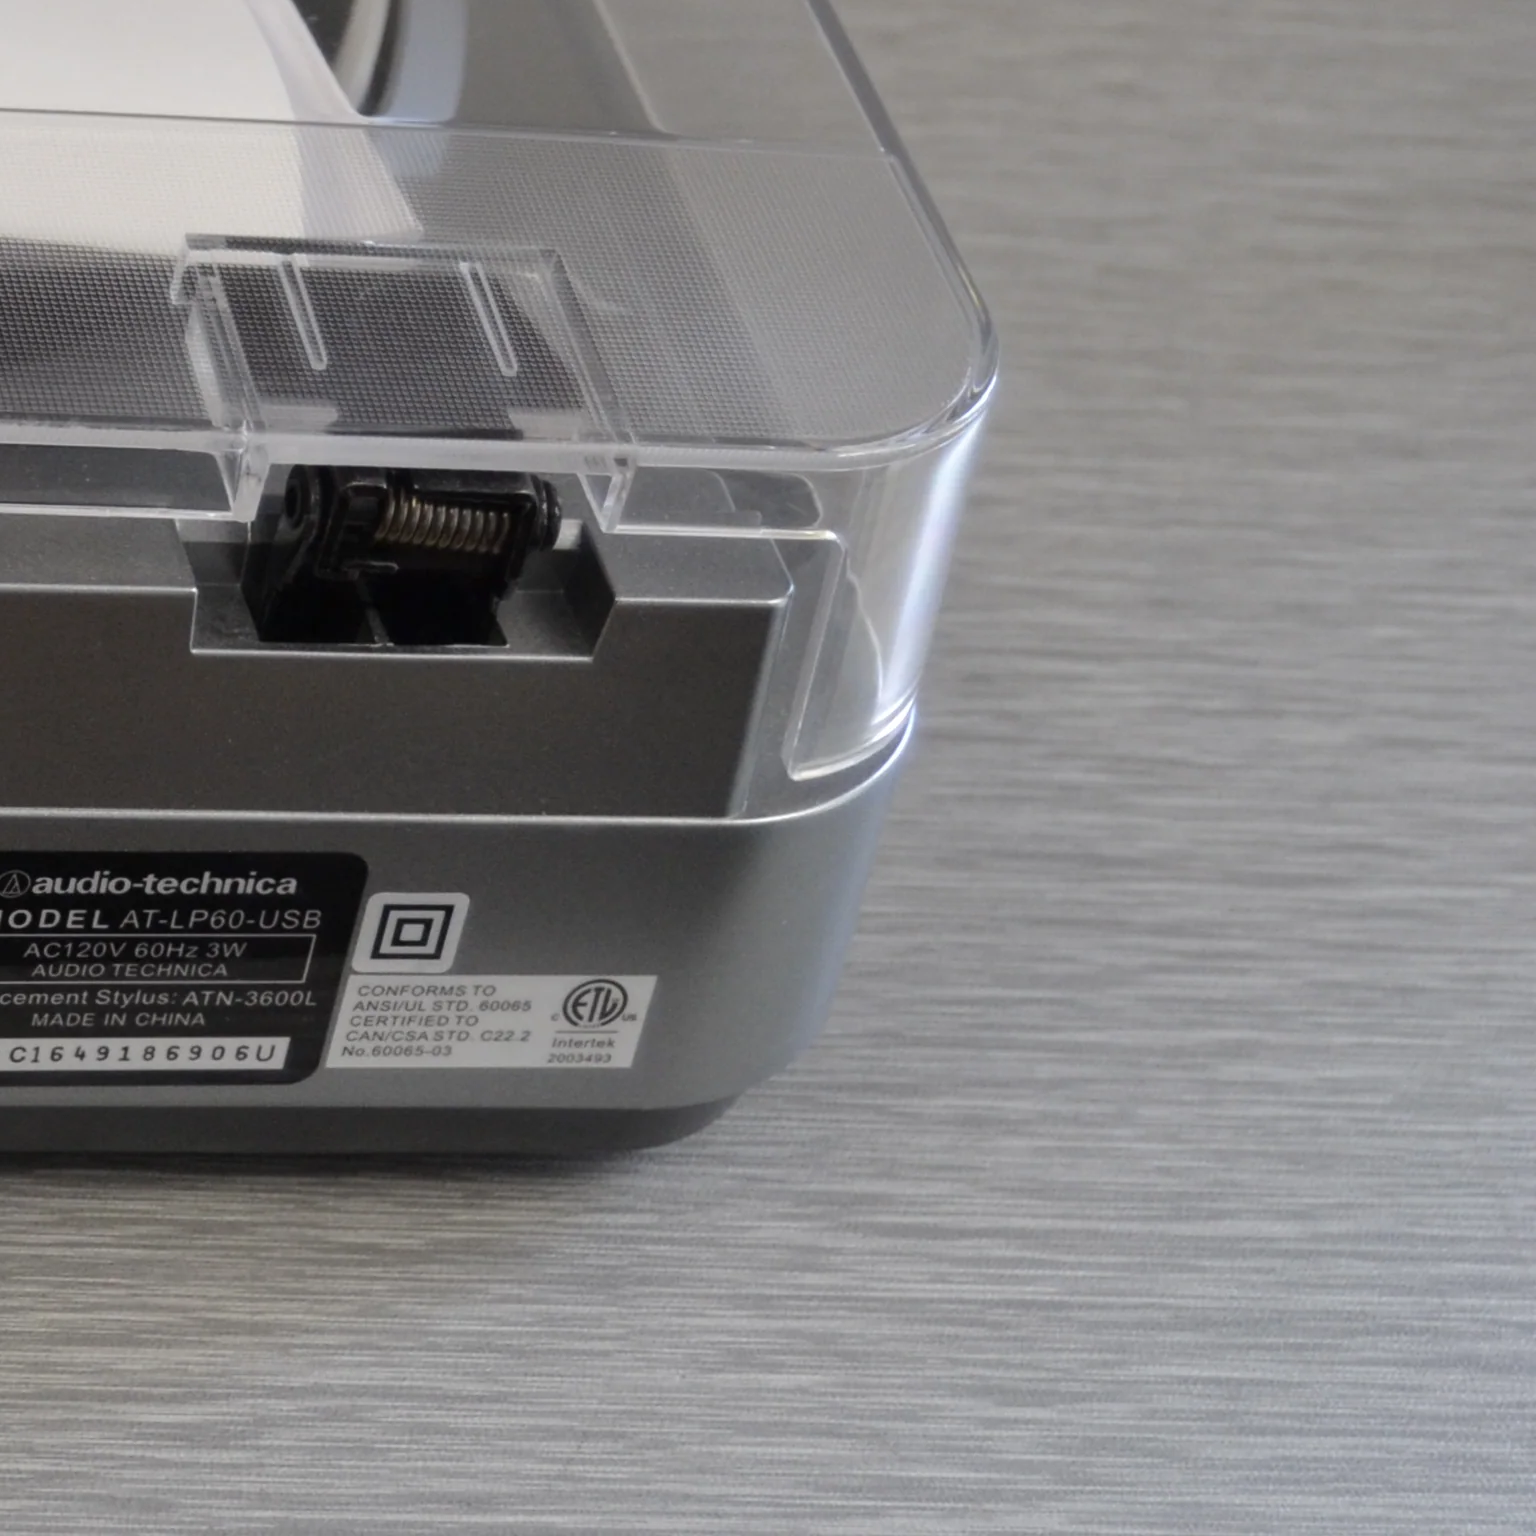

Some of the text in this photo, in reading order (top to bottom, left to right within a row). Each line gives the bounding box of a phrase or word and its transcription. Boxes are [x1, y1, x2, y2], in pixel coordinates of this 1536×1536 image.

[31, 870, 298, 895] audio-technica
[119, 909, 323, 930] AT-LP60-USB
[22, 941, 248, 959] AC120V 60Hz 3W
[31, 962, 229, 978] AUDIO TECHNICA
[357, 984, 497, 997] CONFORMS TO
[94, 988, 178, 1009] Stylus:
[181, 989, 318, 1007] ATN-3600L
[352, 1000, 427, 1013] ANSI/UL
[478, 1000, 533, 1013] 60065
[31, 1012, 206, 1027] MADE IN CHINA
[349, 1015, 480, 1028] CERTIFIED TO
[345, 1030, 429, 1043] CAN/CSA
[480, 1030, 533, 1043] C22.2
[551, 1037, 616, 1049] Intertek
